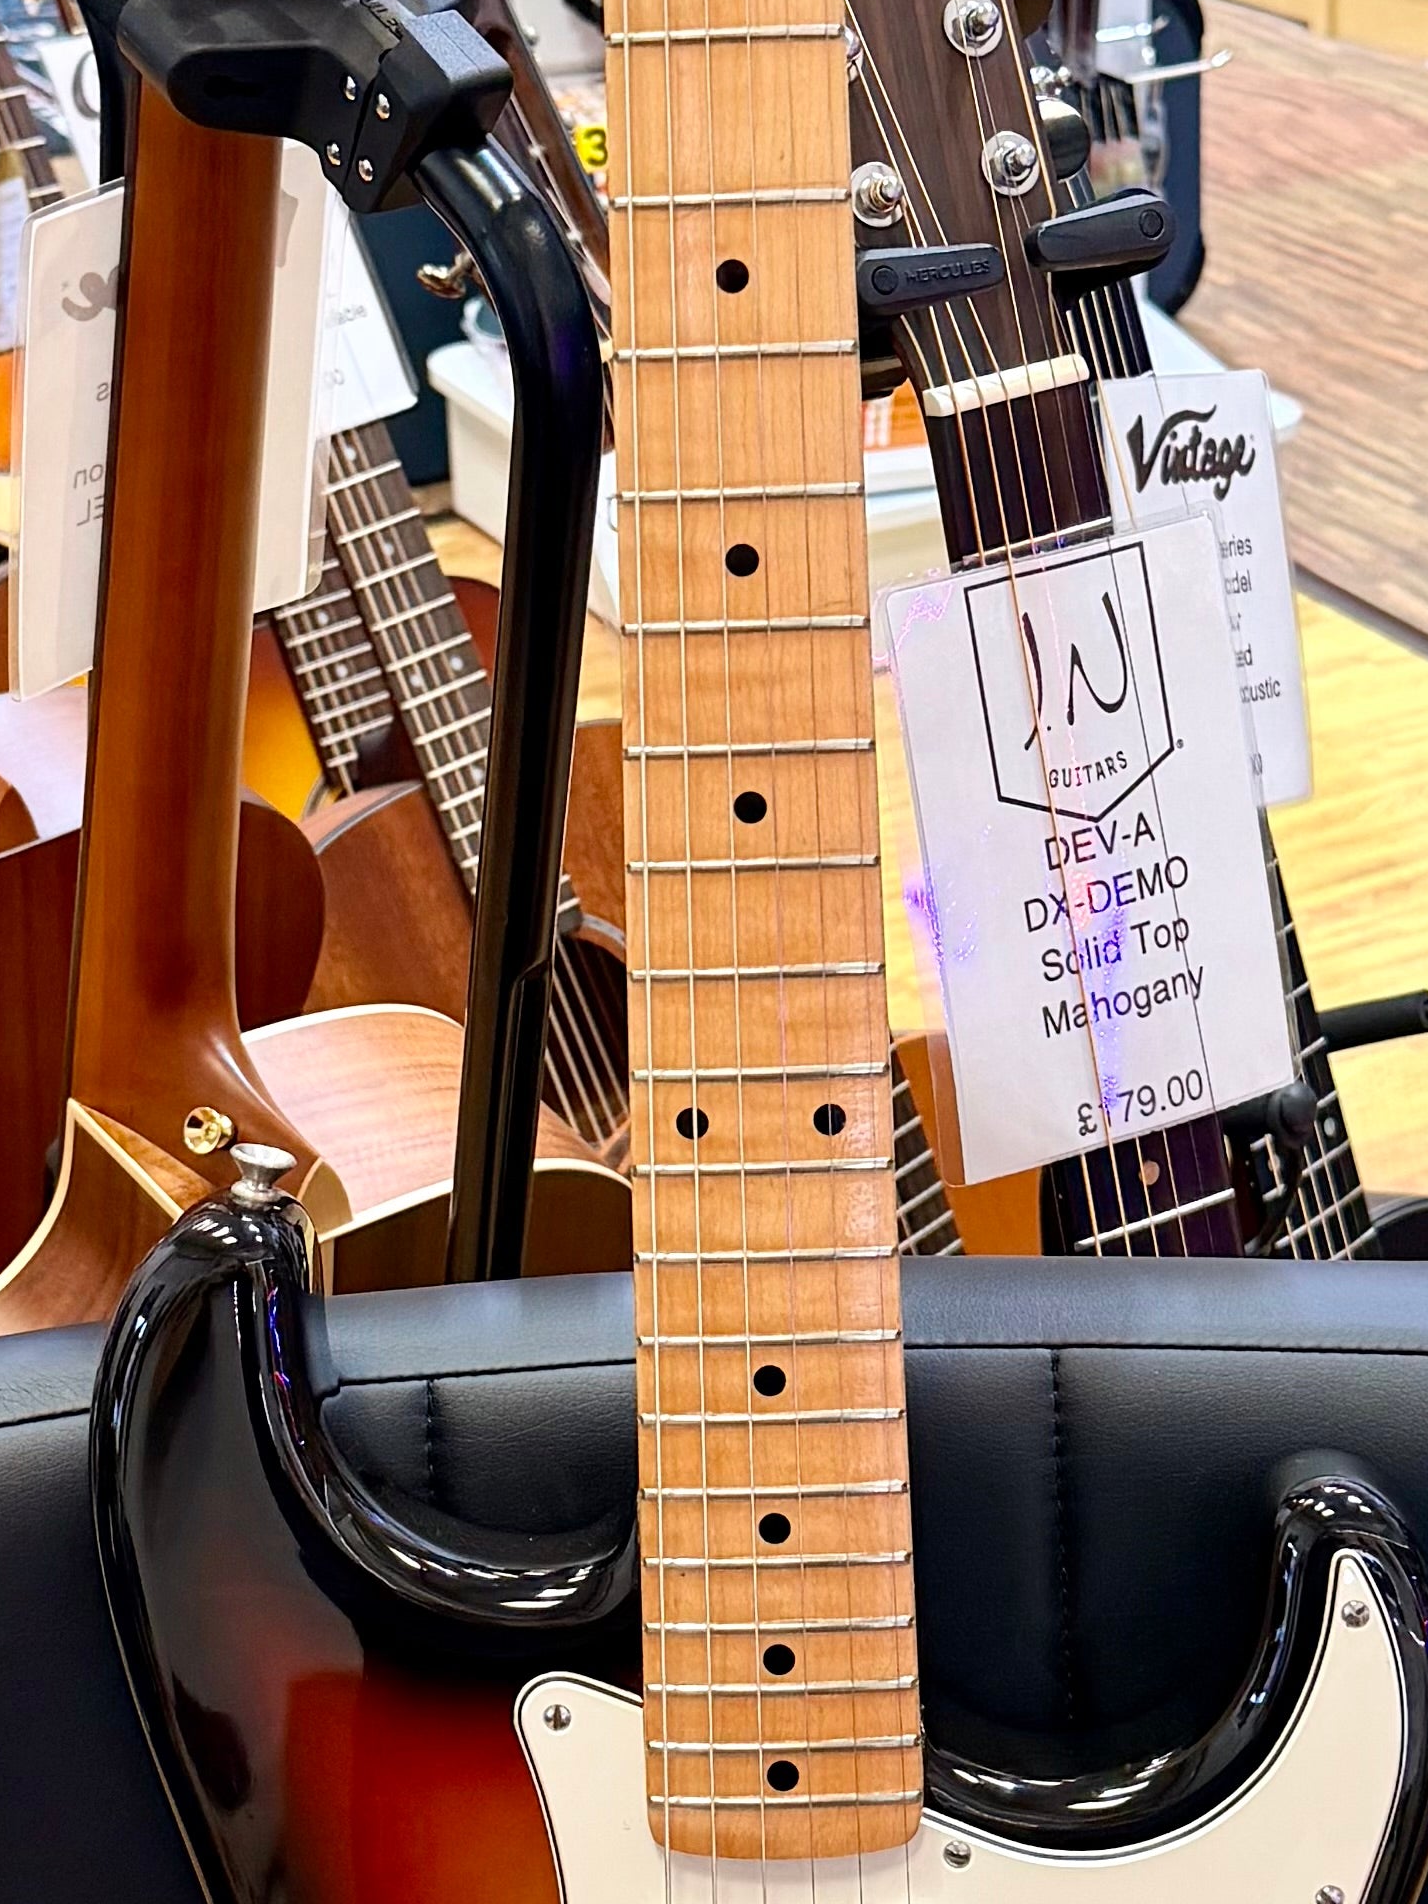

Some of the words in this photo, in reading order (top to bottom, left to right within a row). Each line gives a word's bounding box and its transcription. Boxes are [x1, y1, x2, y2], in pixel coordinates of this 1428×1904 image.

[1126, 403, 1256, 503] Vintage
[1220, 534, 1253, 561] eries
[1048, 751, 1129, 790] GUITARS
[1043, 812, 1156, 872] DEV-A
[1023, 855, 1190, 934] DX-DEMO
[1041, 934, 1123, 983] Solid
[1132, 916, 1190, 964] Top
[1042, 964, 1205, 1039] Mahogany
[1077, 1068, 1204, 1137] £179.00
